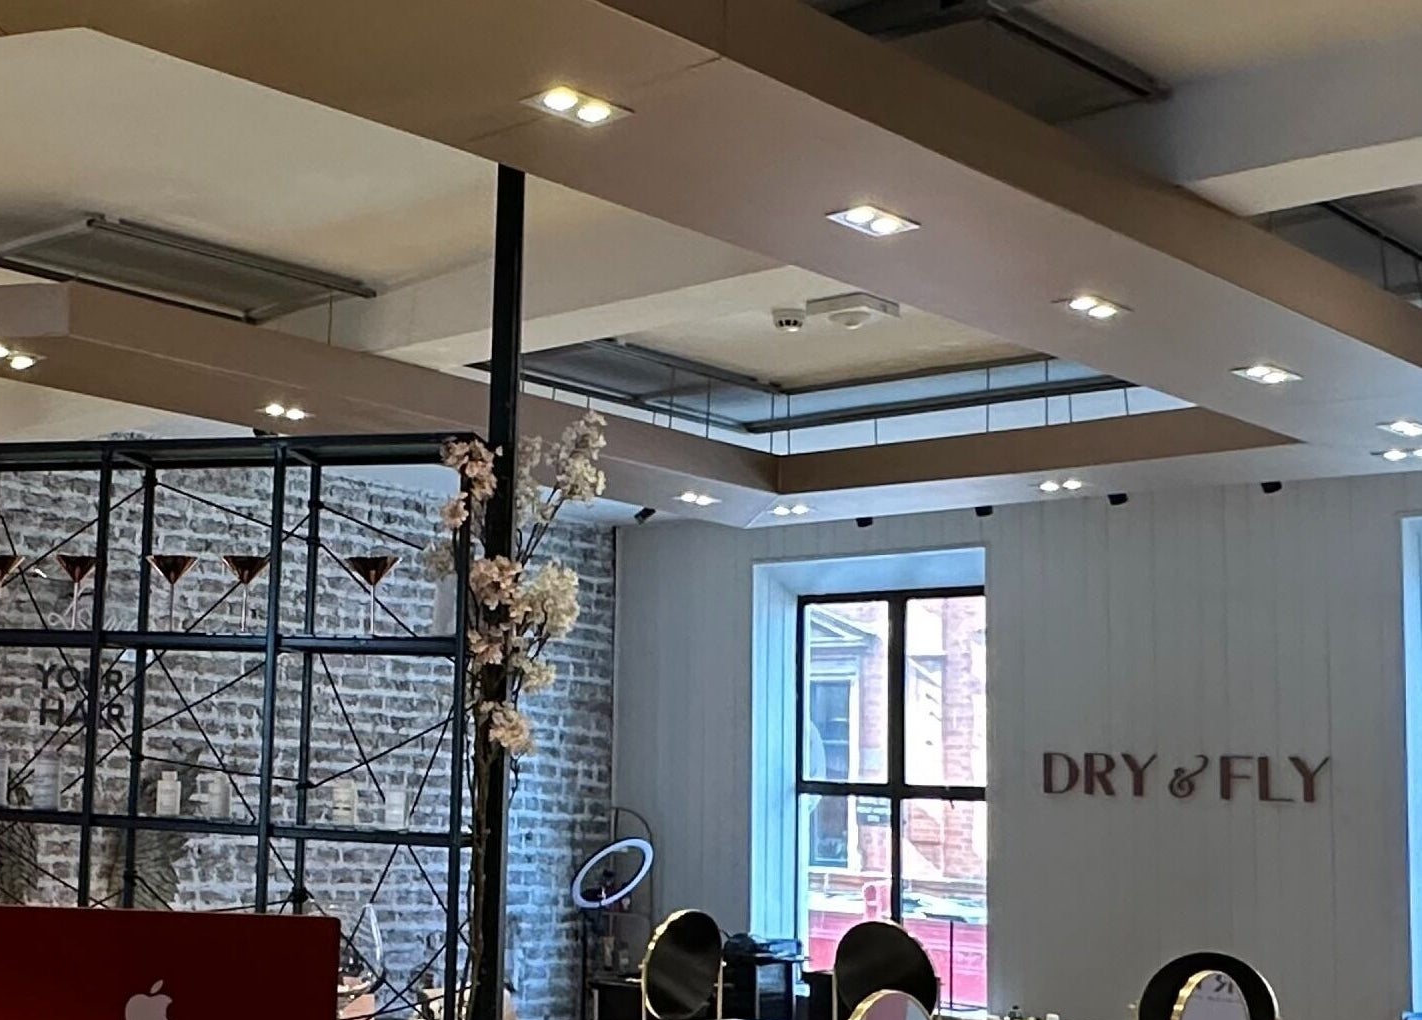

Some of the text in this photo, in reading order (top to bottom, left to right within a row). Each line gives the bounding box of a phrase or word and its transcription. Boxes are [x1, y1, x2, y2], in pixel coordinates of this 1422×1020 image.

[1043, 752, 1330, 803] DRY & FLY
